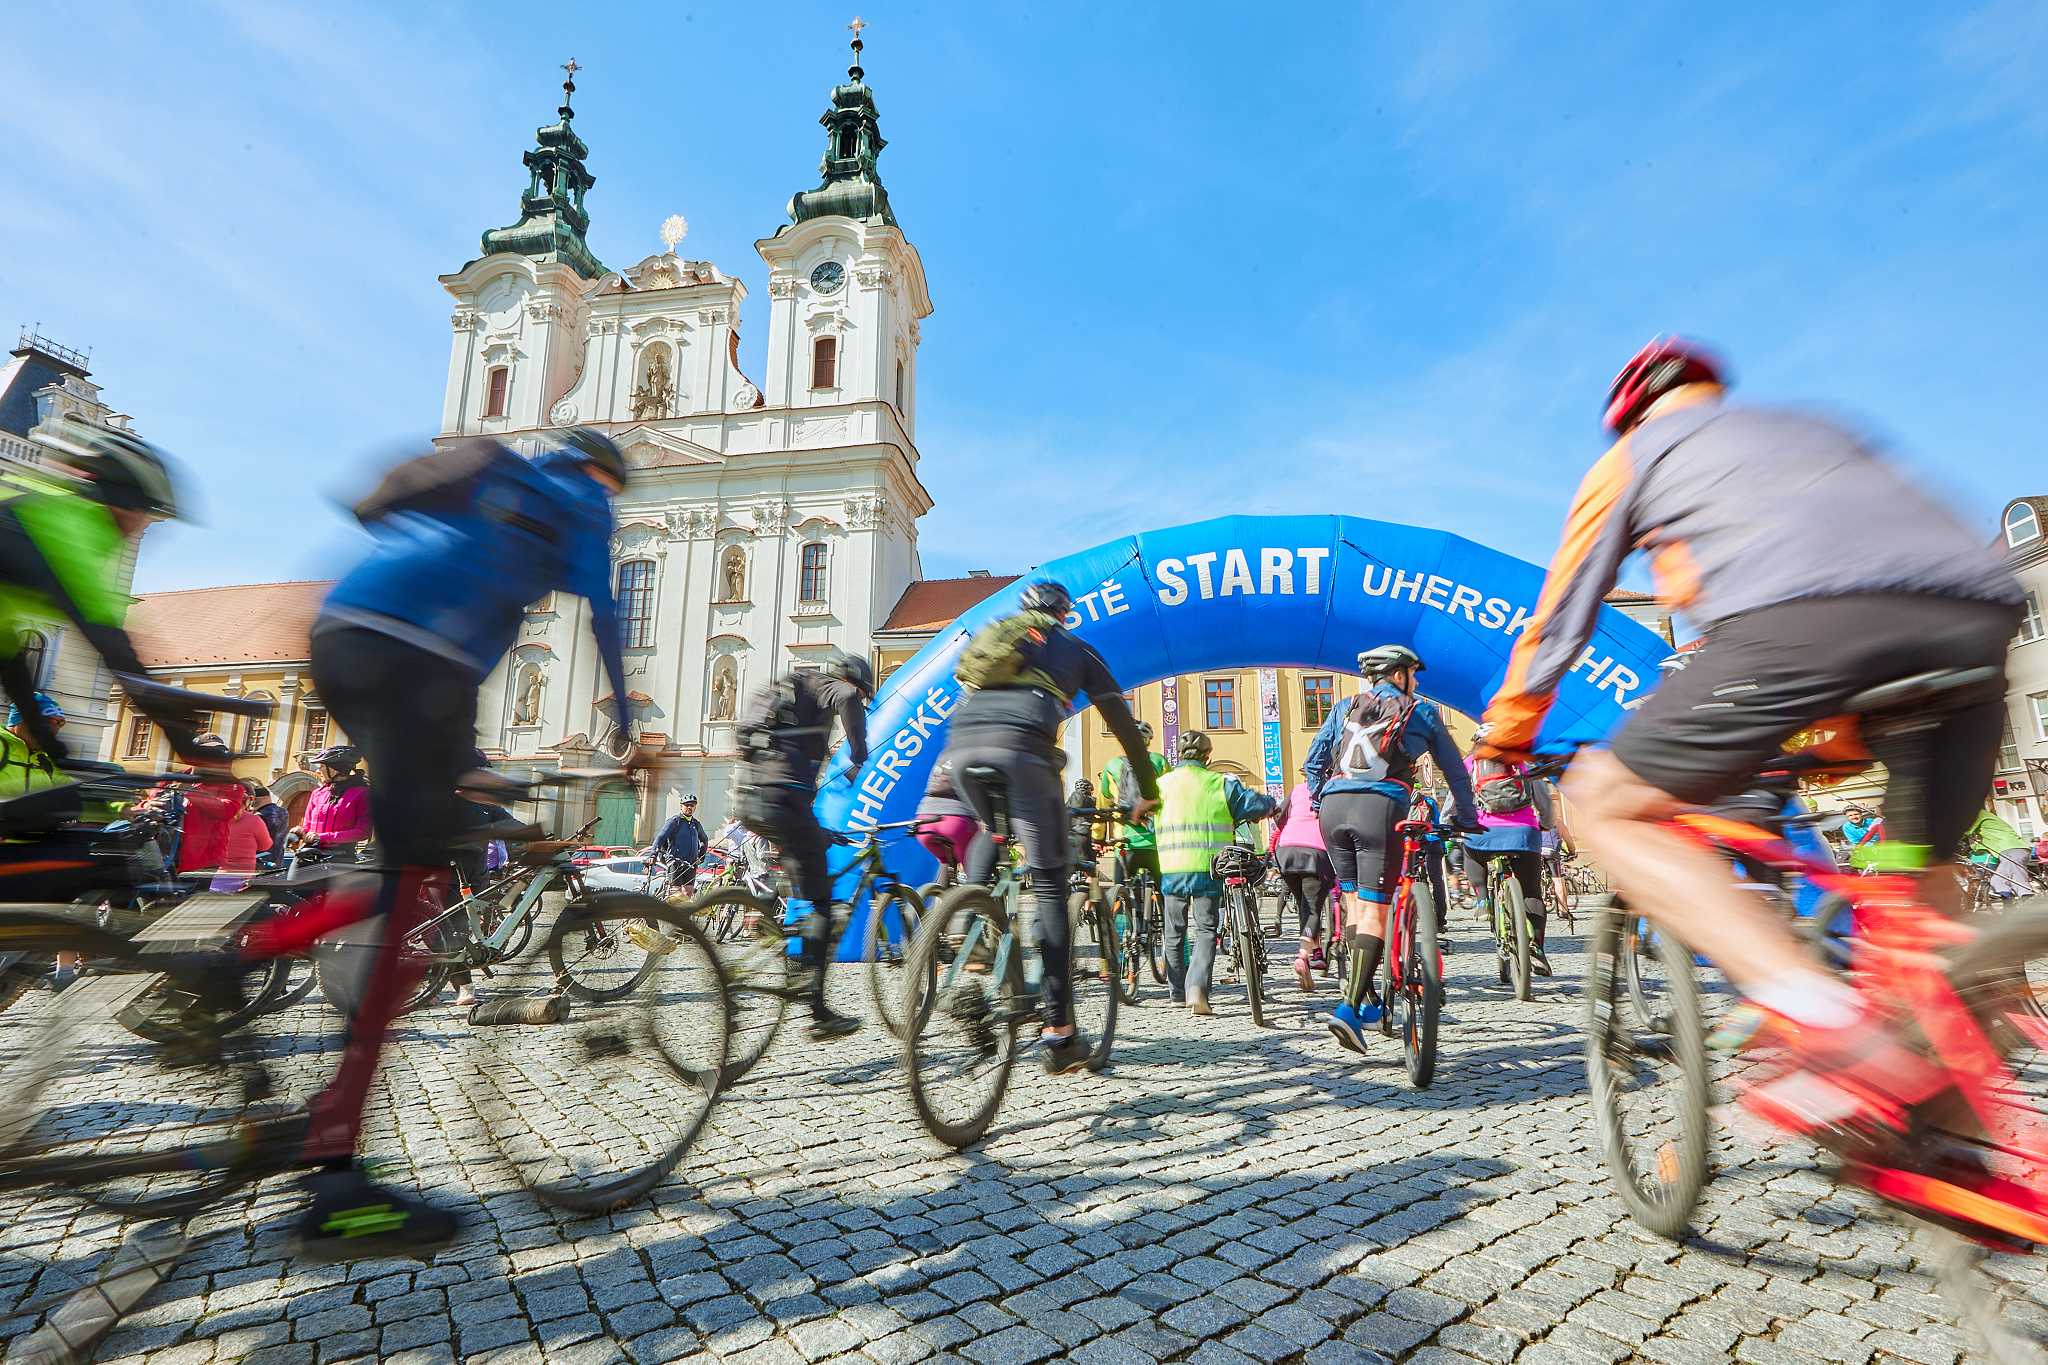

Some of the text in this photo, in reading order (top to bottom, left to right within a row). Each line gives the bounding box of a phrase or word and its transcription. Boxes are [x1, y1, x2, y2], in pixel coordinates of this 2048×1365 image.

[1156, 547, 1329, 606] START
[1363, 564, 1536, 636] UHERSK
[847, 687, 957, 849] UHERSKÉ
